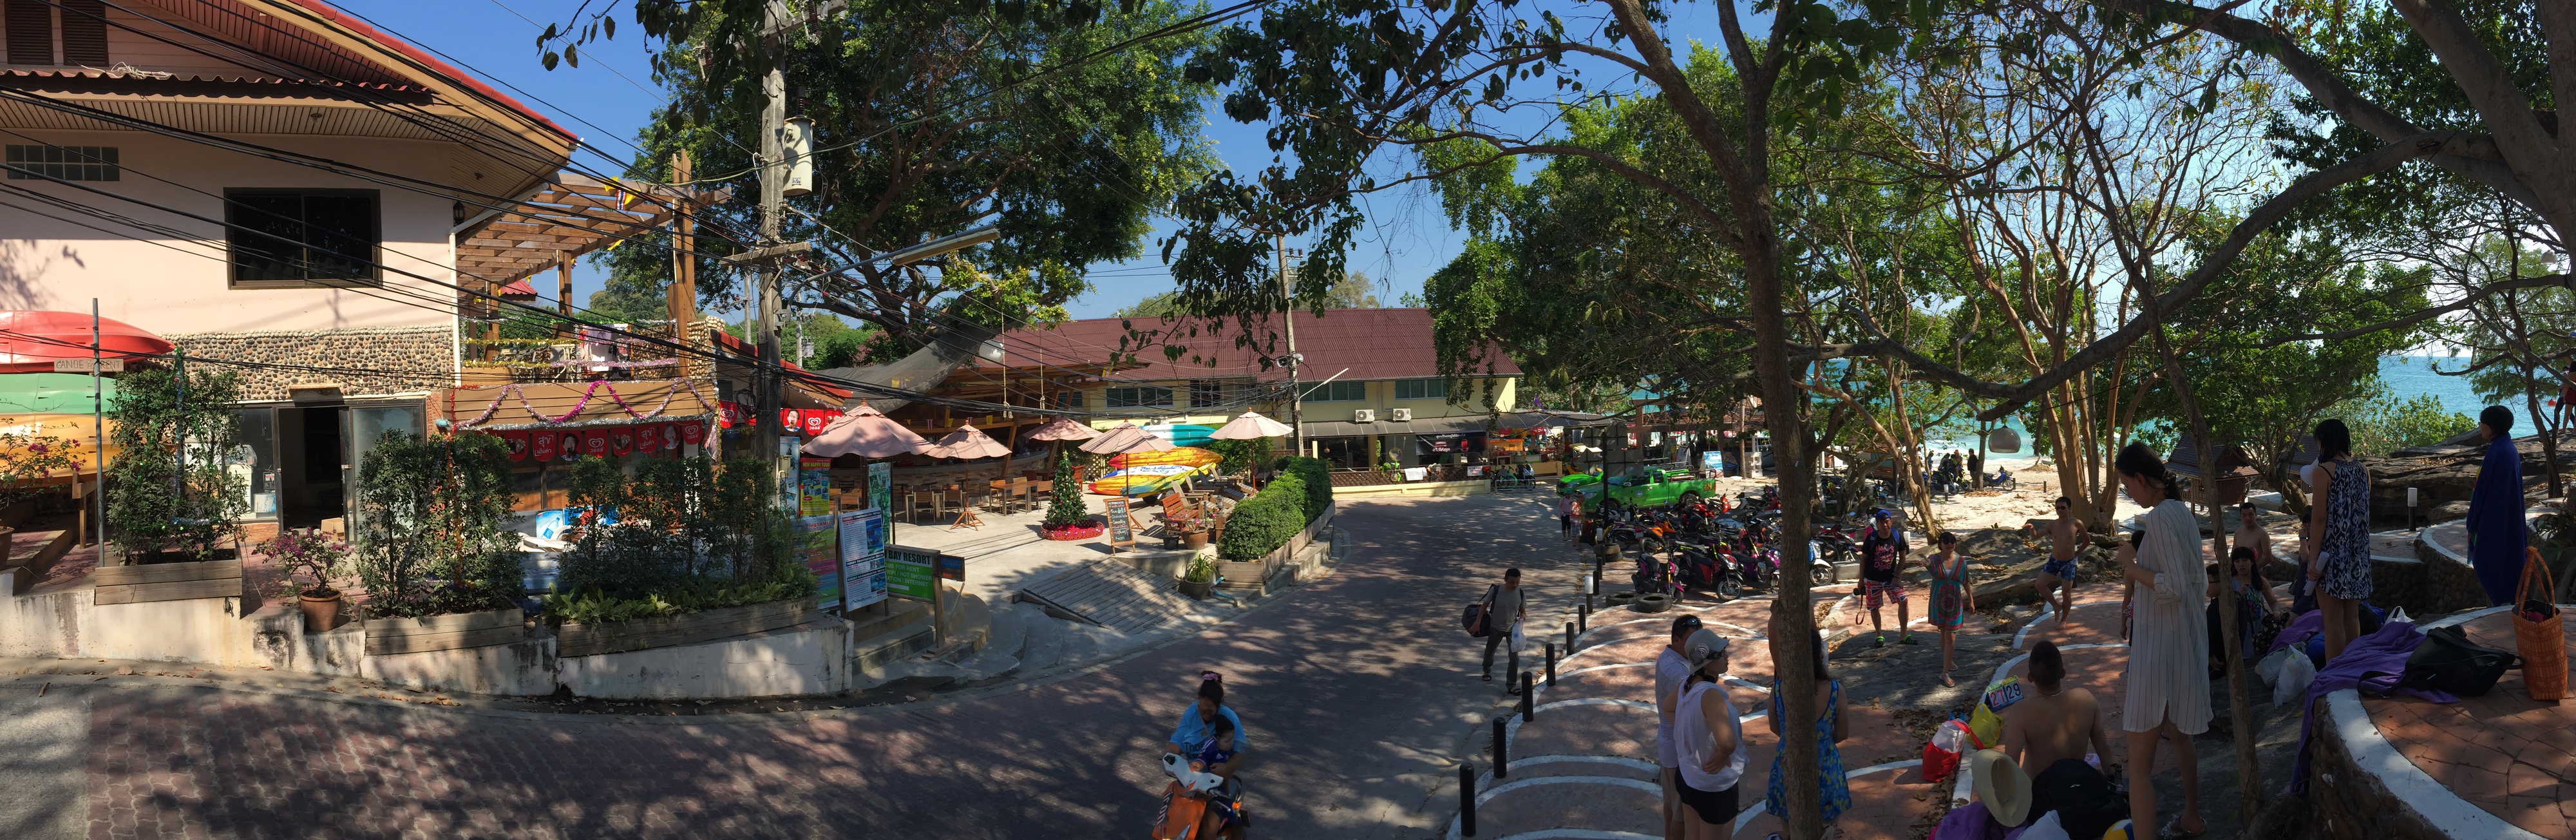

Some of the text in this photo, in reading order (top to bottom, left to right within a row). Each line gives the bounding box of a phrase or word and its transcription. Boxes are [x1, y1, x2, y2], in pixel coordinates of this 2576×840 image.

[56, 360, 84, 369] CANOE
[889, 549, 902, 560] BAY
[903, 552, 931, 565] RESORT
[905, 578, 929, 587] INTERNET
[1990, 683, 2022, 707] 27 29
